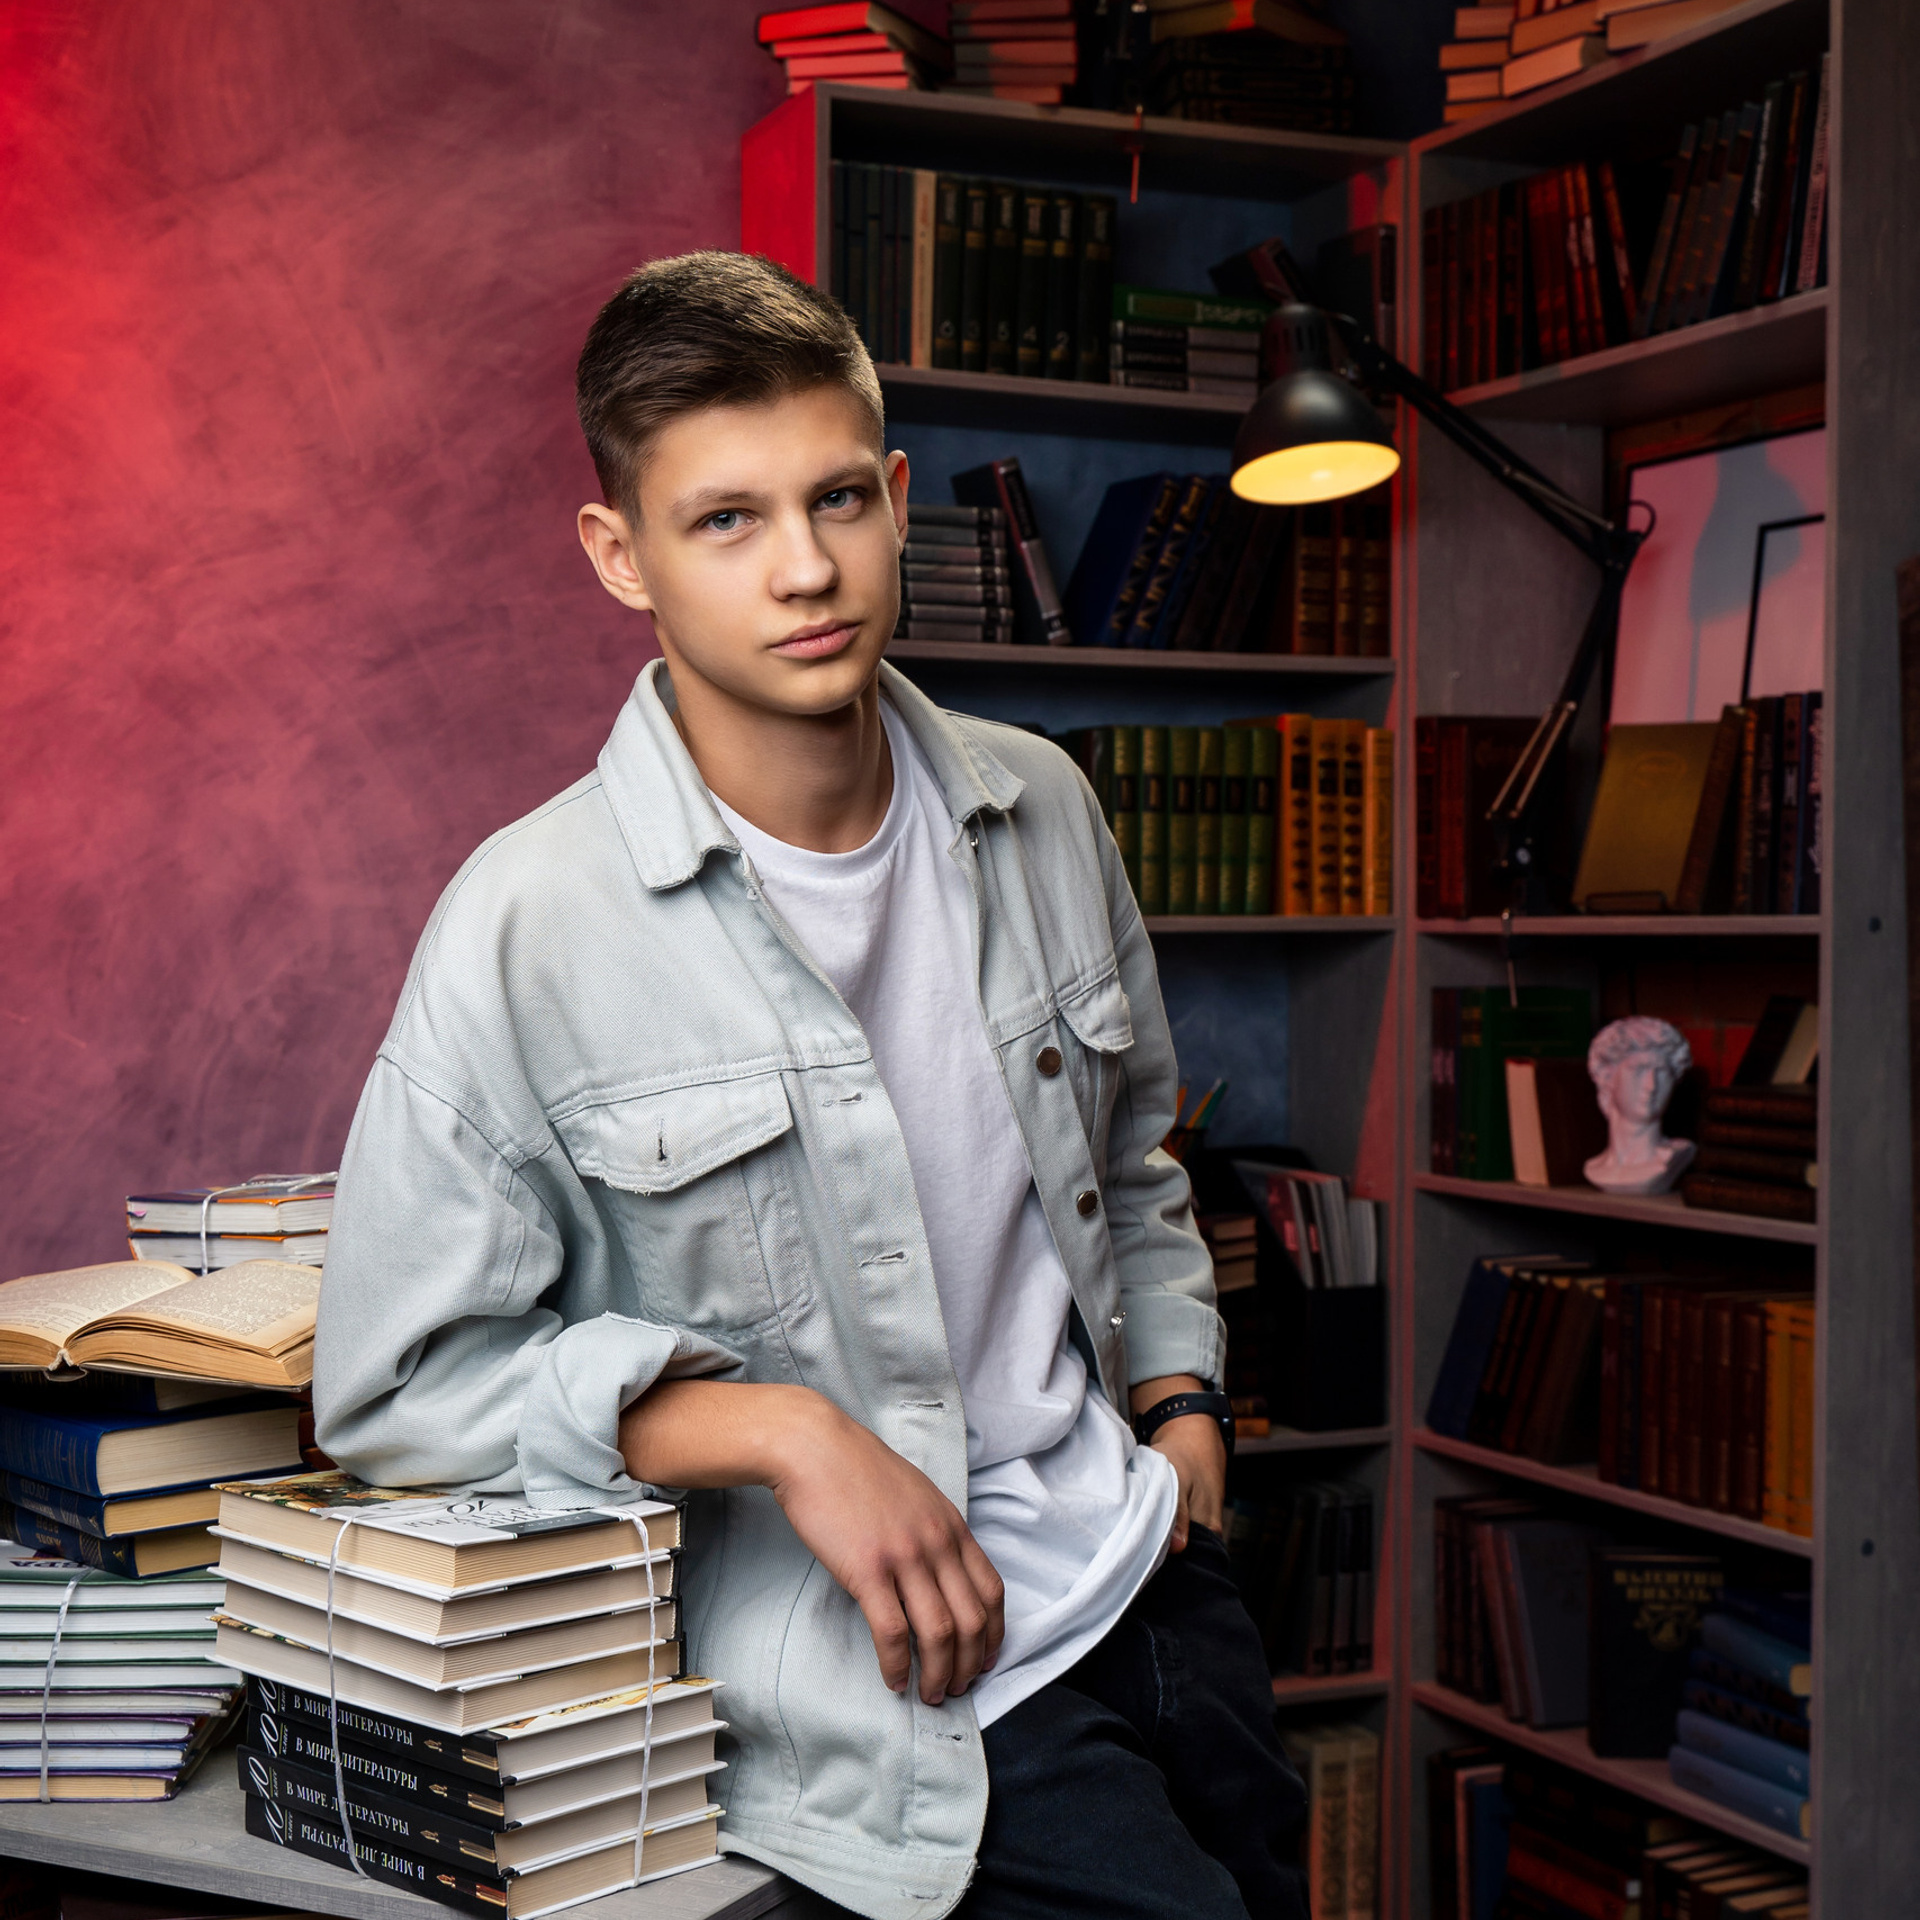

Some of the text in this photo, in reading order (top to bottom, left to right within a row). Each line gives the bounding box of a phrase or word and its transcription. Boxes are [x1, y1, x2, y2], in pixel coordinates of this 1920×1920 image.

[446, 1499, 493, 1516] 10
[260, 1713, 279, 1758] 10
[294, 1694, 301, 1709] В
[337, 1708, 413, 1746] ЛИТЕРАТУРЫ
[248, 1756, 270, 1800] 10
[295, 1736, 303, 1752] В
[340, 1752, 418, 1791] ЛИТЕРАТУРЫ
[264, 1800, 284, 1845] 10
[286, 1781, 410, 1836] В МИРЕ ЛТЕРАТУРЫ
[301, 1823, 425, 1881] В МИРЕ ЛИТРАТУРЫ
